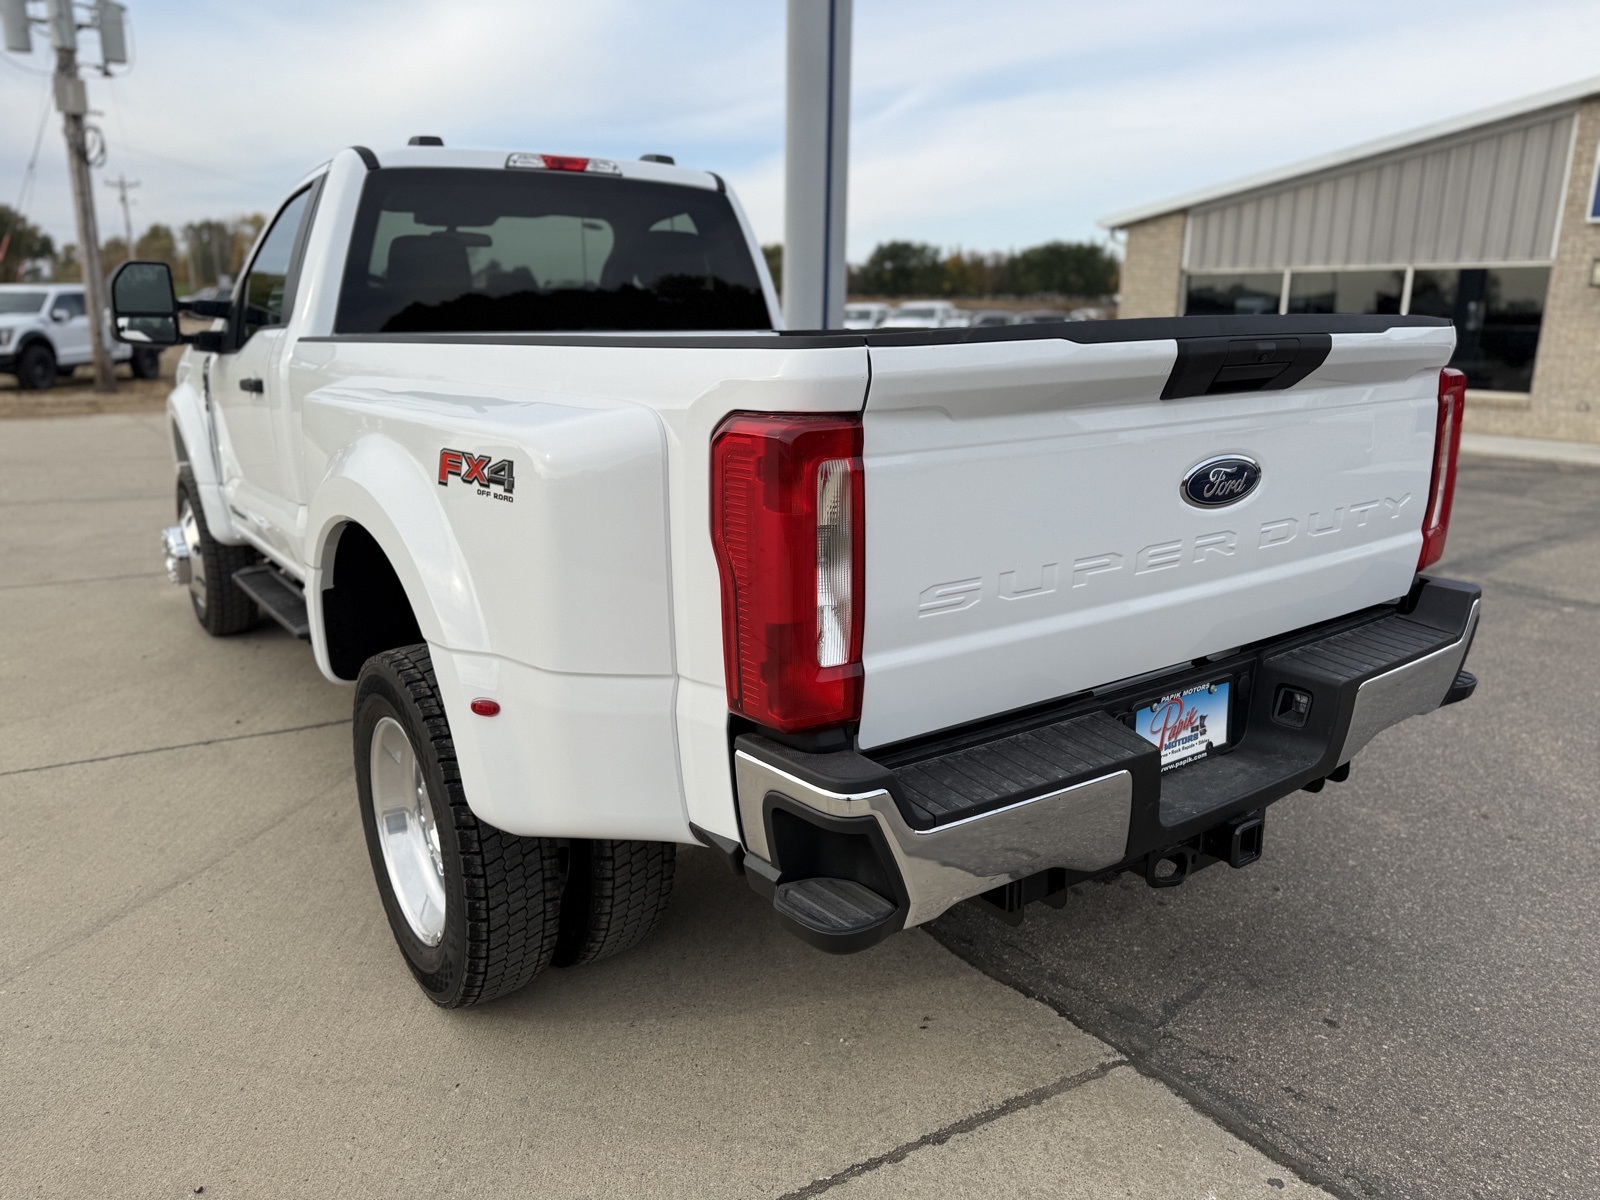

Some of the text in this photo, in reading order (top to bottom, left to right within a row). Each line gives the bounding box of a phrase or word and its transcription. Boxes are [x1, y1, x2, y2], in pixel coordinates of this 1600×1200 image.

[438, 447, 514, 494] FX4
[1203, 466, 1247, 498] Ford
[477, 489, 514, 503] OFF ROAD
[917, 492, 1412, 618] SUPER DUTY
[1161, 683, 1210, 703] PAPIK MOTORS
[1150, 697, 1199, 751] Papik
[1164, 732, 1199, 751] MOTORS
